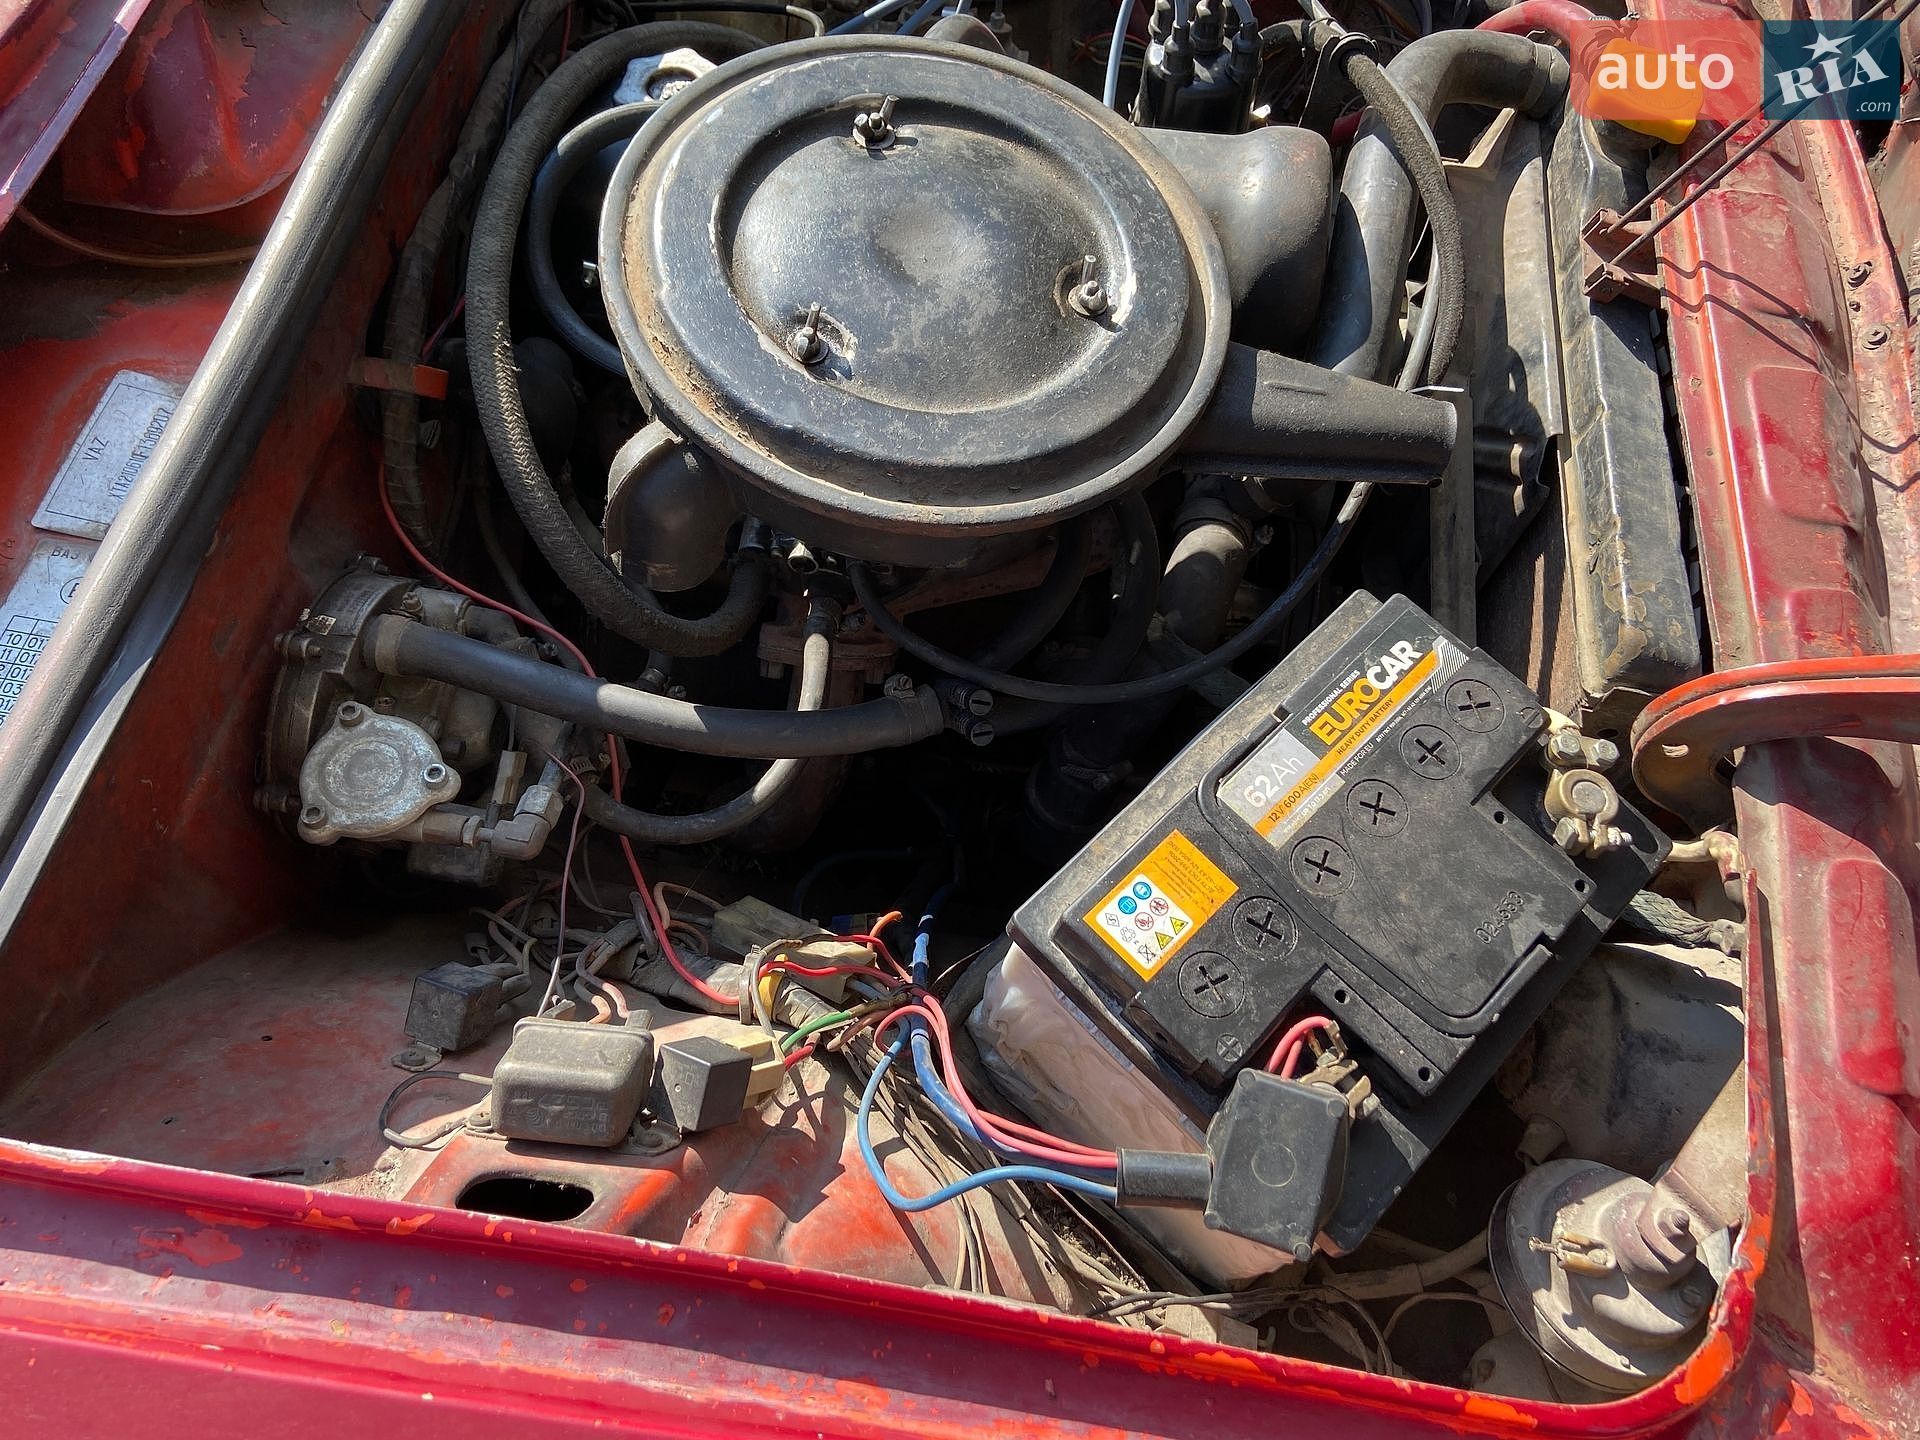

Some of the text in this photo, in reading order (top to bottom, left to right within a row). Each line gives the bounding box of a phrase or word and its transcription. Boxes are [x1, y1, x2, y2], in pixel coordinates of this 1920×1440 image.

[82, 437, 109, 460] VAZ
[0, 647, 13, 661] 11
[6, 633, 23, 646] 10
[1301, 687, 1342, 726] PROFESSIONAL
[1339, 669, 1360, 688] SERIES
[1309, 640, 1423, 746] EUROCAR
[1336, 697, 1395, 755] HEAVY DUTY BATTERY
[1339, 742, 1375, 776] MADE FOR EU
[1243, 757, 1304, 808] 62Ah
[1268, 804, 1285, 823] 12V
